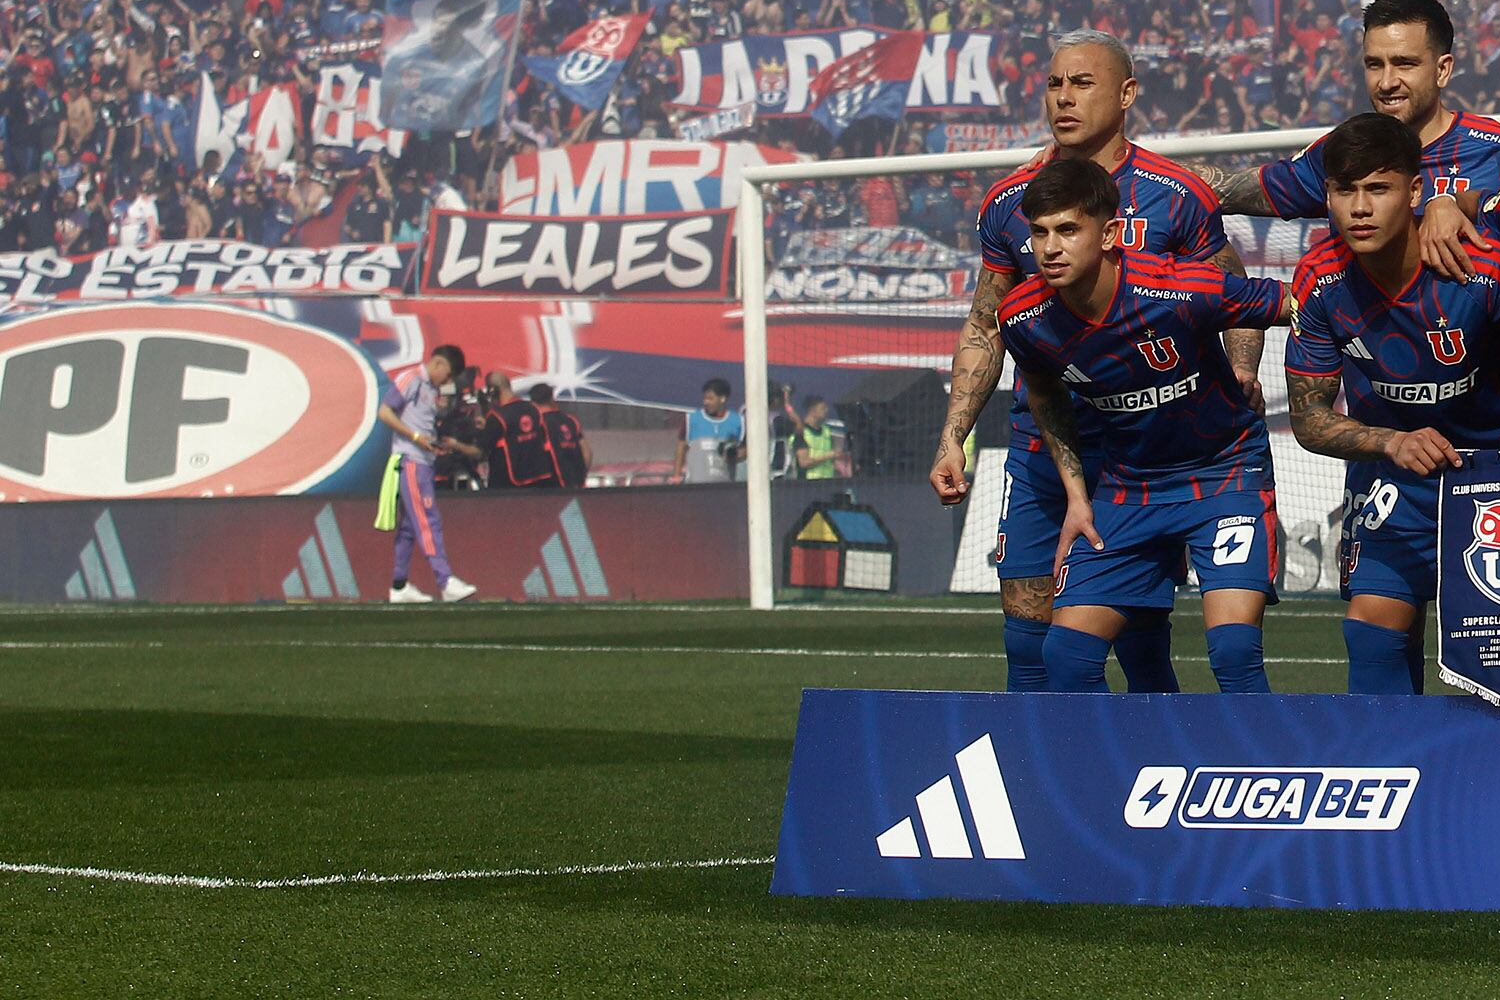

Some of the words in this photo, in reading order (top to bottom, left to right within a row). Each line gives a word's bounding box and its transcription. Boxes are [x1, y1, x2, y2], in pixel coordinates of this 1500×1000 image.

[1134, 168, 1189, 198] MACHBANK
[99, 240, 402, 271] IMPORTA
[436, 215, 714, 291] LEALES
[80, 262, 392, 298] ESTADIO
[1133, 284, 1193, 302] MACHBANK
[1137, 336, 1180, 371] U
[1426, 328, 1467, 365] U
[1374, 368, 1477, 404] JUGABET
[0, 336, 248, 485] PF
[1452, 485, 1470, 495] CLUB
[1471, 629, 1496, 637] PRIMERA
[1187, 776, 1410, 820] JUGABET
